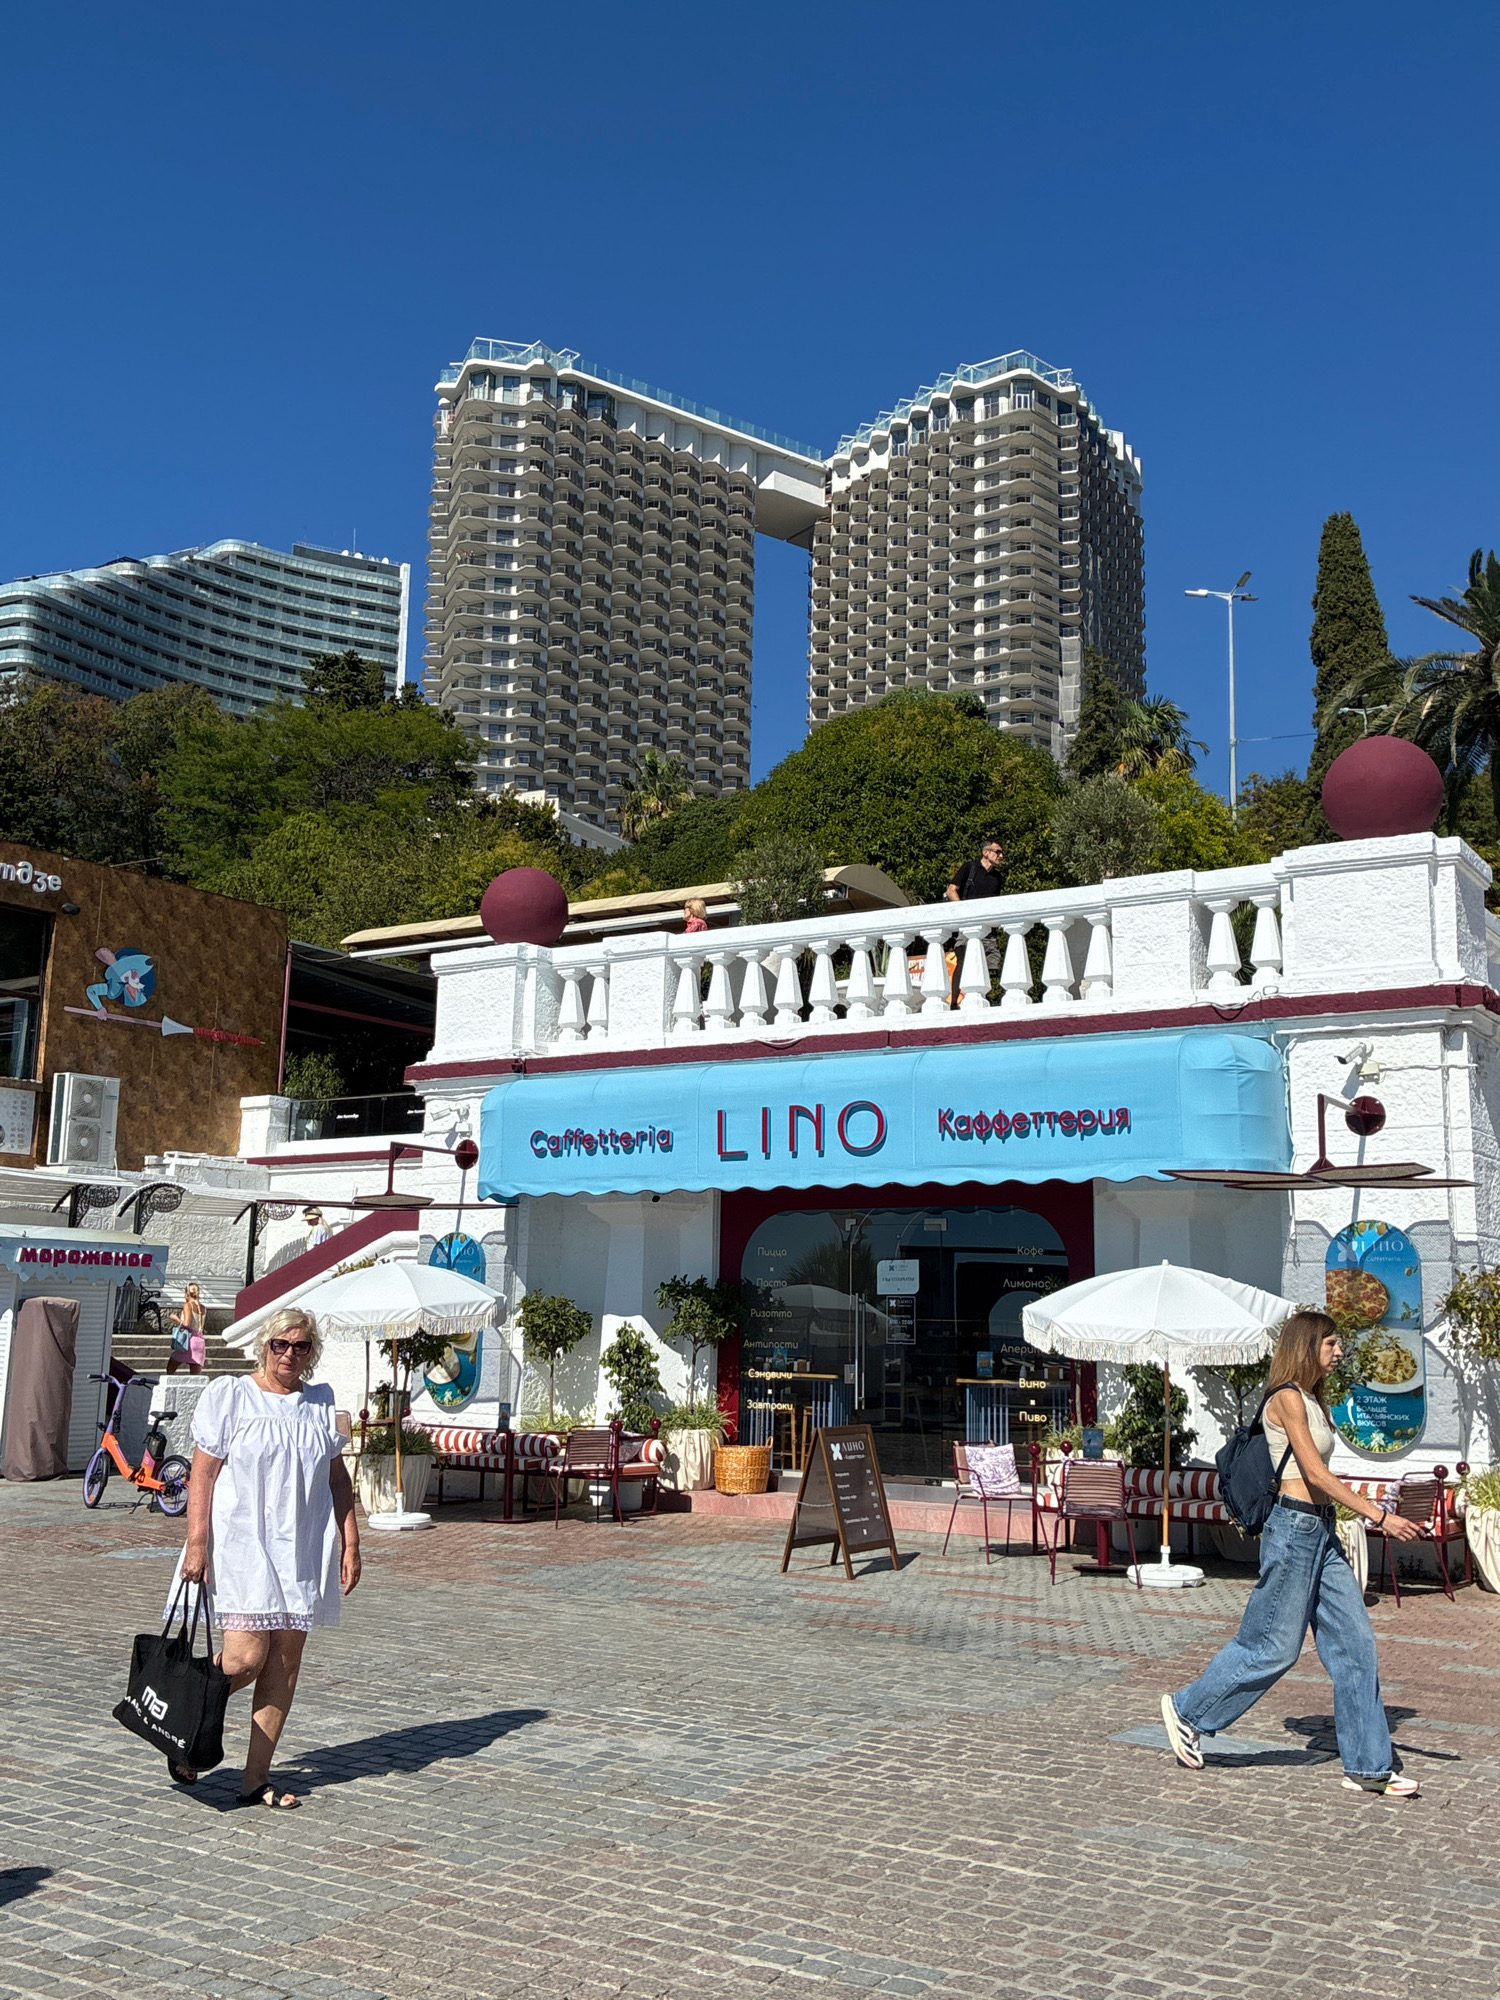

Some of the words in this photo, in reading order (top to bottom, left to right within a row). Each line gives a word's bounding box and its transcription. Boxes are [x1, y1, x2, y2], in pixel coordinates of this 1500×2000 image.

[716, 1100, 887, 1158] LINO
[938, 1107, 1131, 1141] Каффеттерия
[530, 1125, 673, 1156] Caffetteria
[757, 1247, 788, 1257] Пицца
[1017, 1246, 1044, 1257] Кофе
[17, 1247, 153, 1268] мороженое
[756, 1277, 788, 1288] Паста
[1003, 1278, 1052, 1291] Лимонад
[750, 1308, 793, 1319] Ризотто
[743, 1339, 799, 1350] Антипасти
[748, 1368, 793, 1381] Сэндвичи
[1019, 1378, 1046, 1389] Вино
[1356, 1395, 1361, 1404] 2
[1363, 1395, 1387, 1404] ЭТАЖ
[746, 1399, 794, 1412] Завтраки
[1356, 1405, 1388, 1414] БОЛЬШЕ
[1019, 1411, 1047, 1422] Пиво
[1356, 1412, 1410, 1421] ИТАЛЬЯНСКИХ
